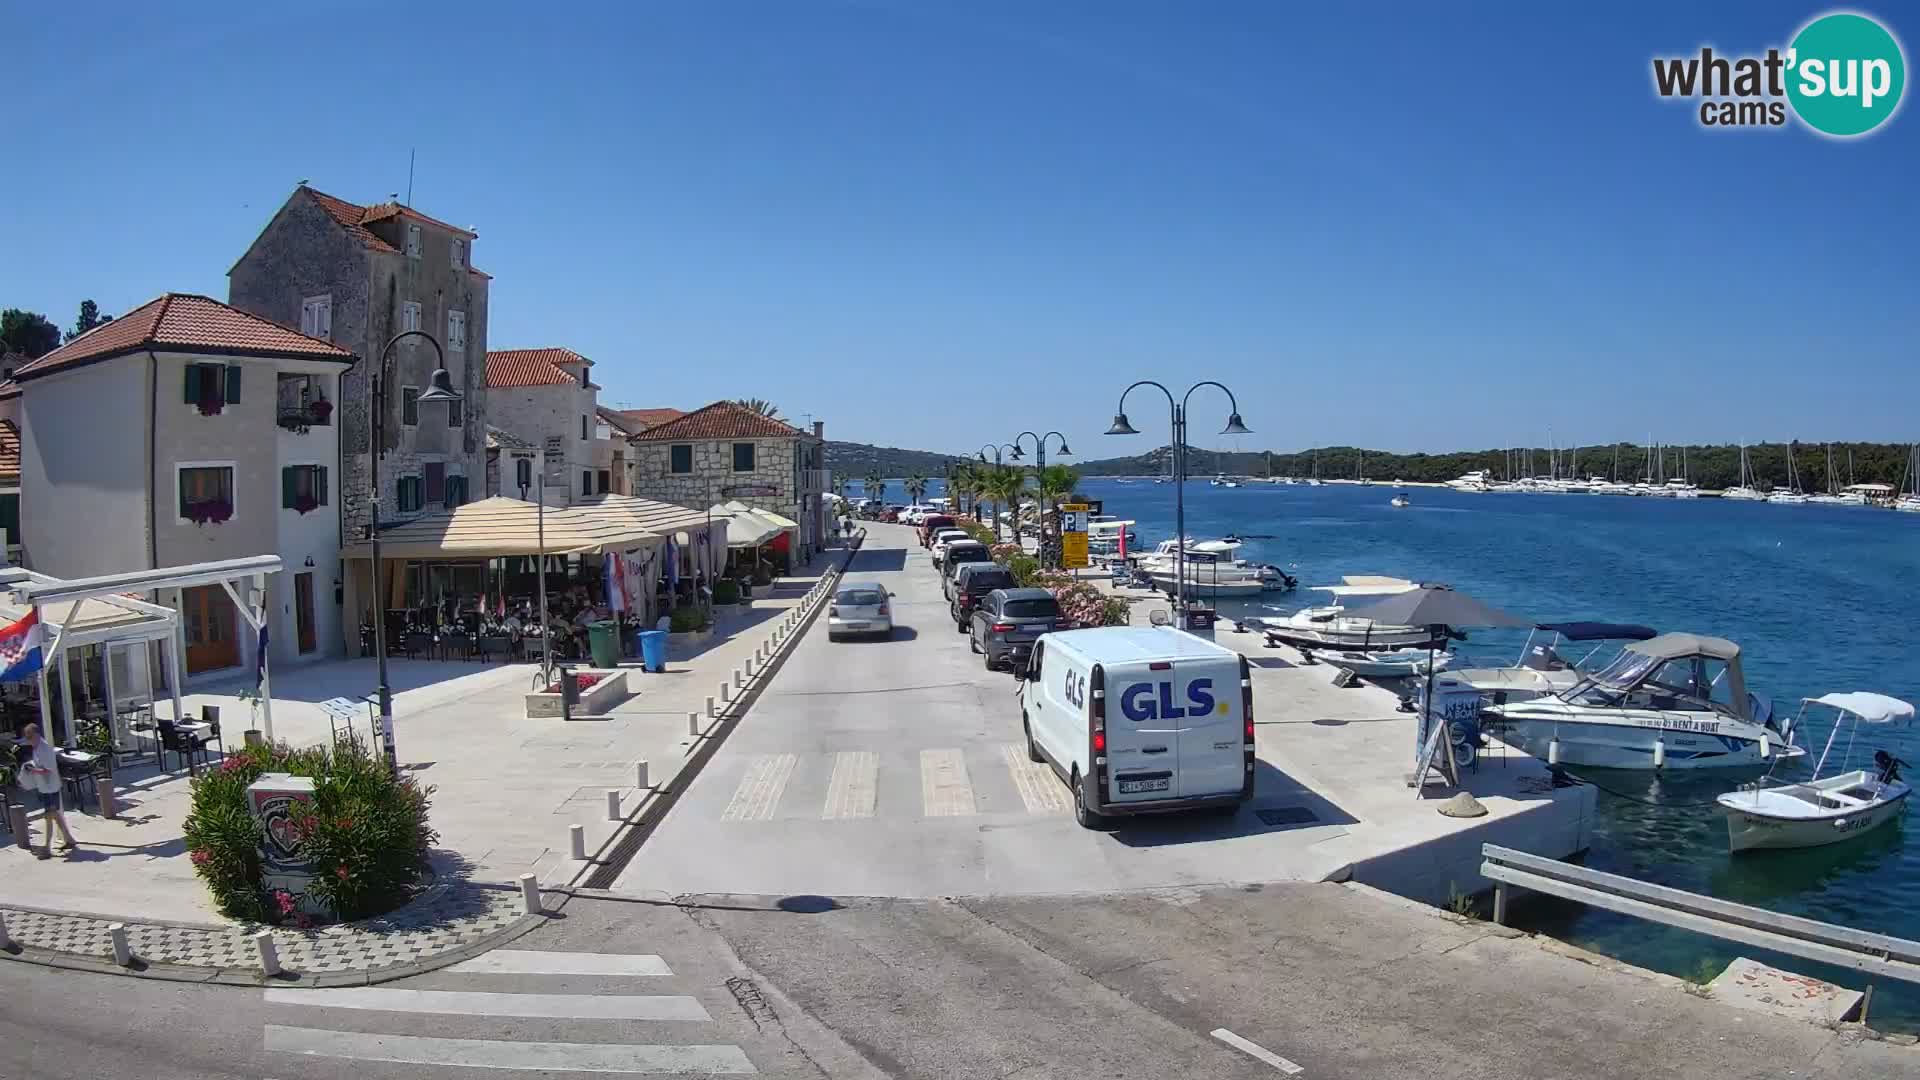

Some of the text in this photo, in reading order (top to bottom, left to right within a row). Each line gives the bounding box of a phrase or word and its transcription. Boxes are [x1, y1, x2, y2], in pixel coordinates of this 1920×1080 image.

[1064, 514, 1076, 530] P
[1065, 668, 1085, 710] GLS
[1120, 678, 1215, 722] GLS
[1672, 719, 1693, 730] RENT
